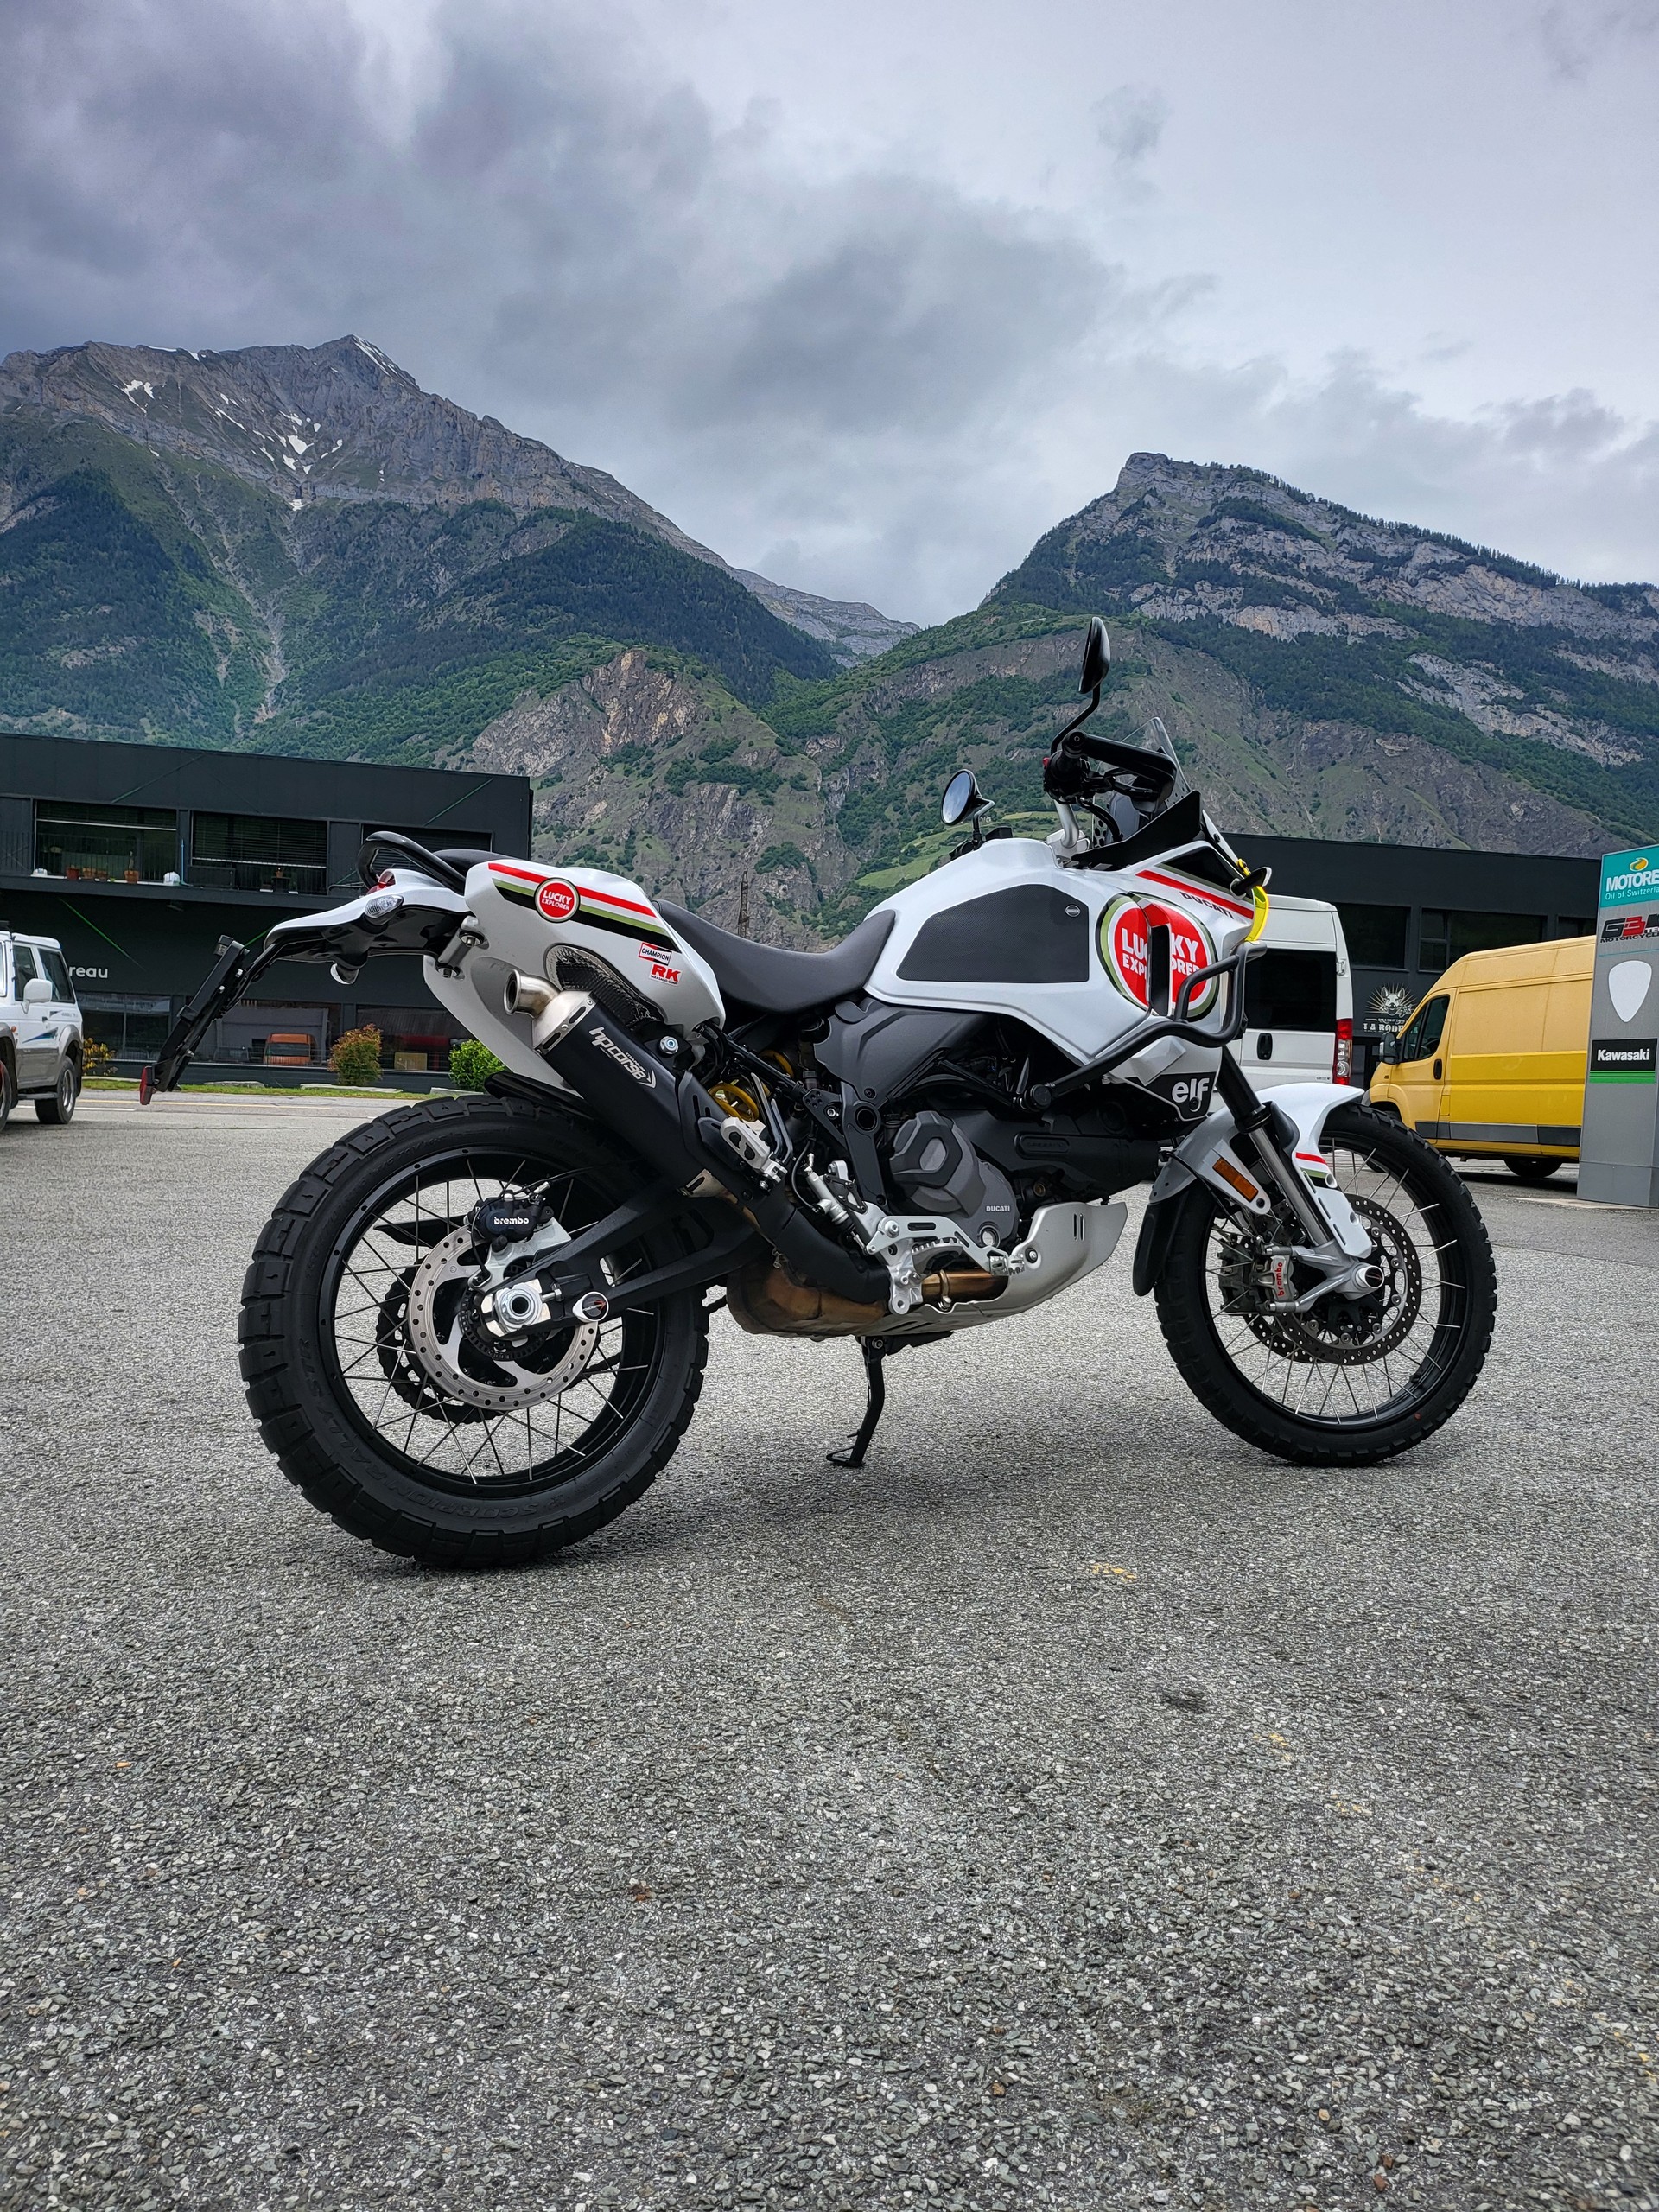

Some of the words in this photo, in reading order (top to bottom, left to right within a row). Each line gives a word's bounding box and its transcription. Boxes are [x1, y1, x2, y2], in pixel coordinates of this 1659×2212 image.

[543, 890, 572, 905] LUCKY
[1617, 890, 1625, 899] of
[542, 898, 570, 911] EXPLORER
[1179, 891, 1235, 919] DUCATI
[1122, 927, 1199, 963] LUKY
[641, 948, 670, 961] CHAMPION
[69, 966, 108, 978] reau
[652, 964, 681, 982] RK
[1597, 1048, 1650, 1061] Kawasaki
[1172, 1077, 1210, 1103] elf
[493, 1216, 530, 1225] brembo
[1274, 1262, 1285, 1297] brembo
